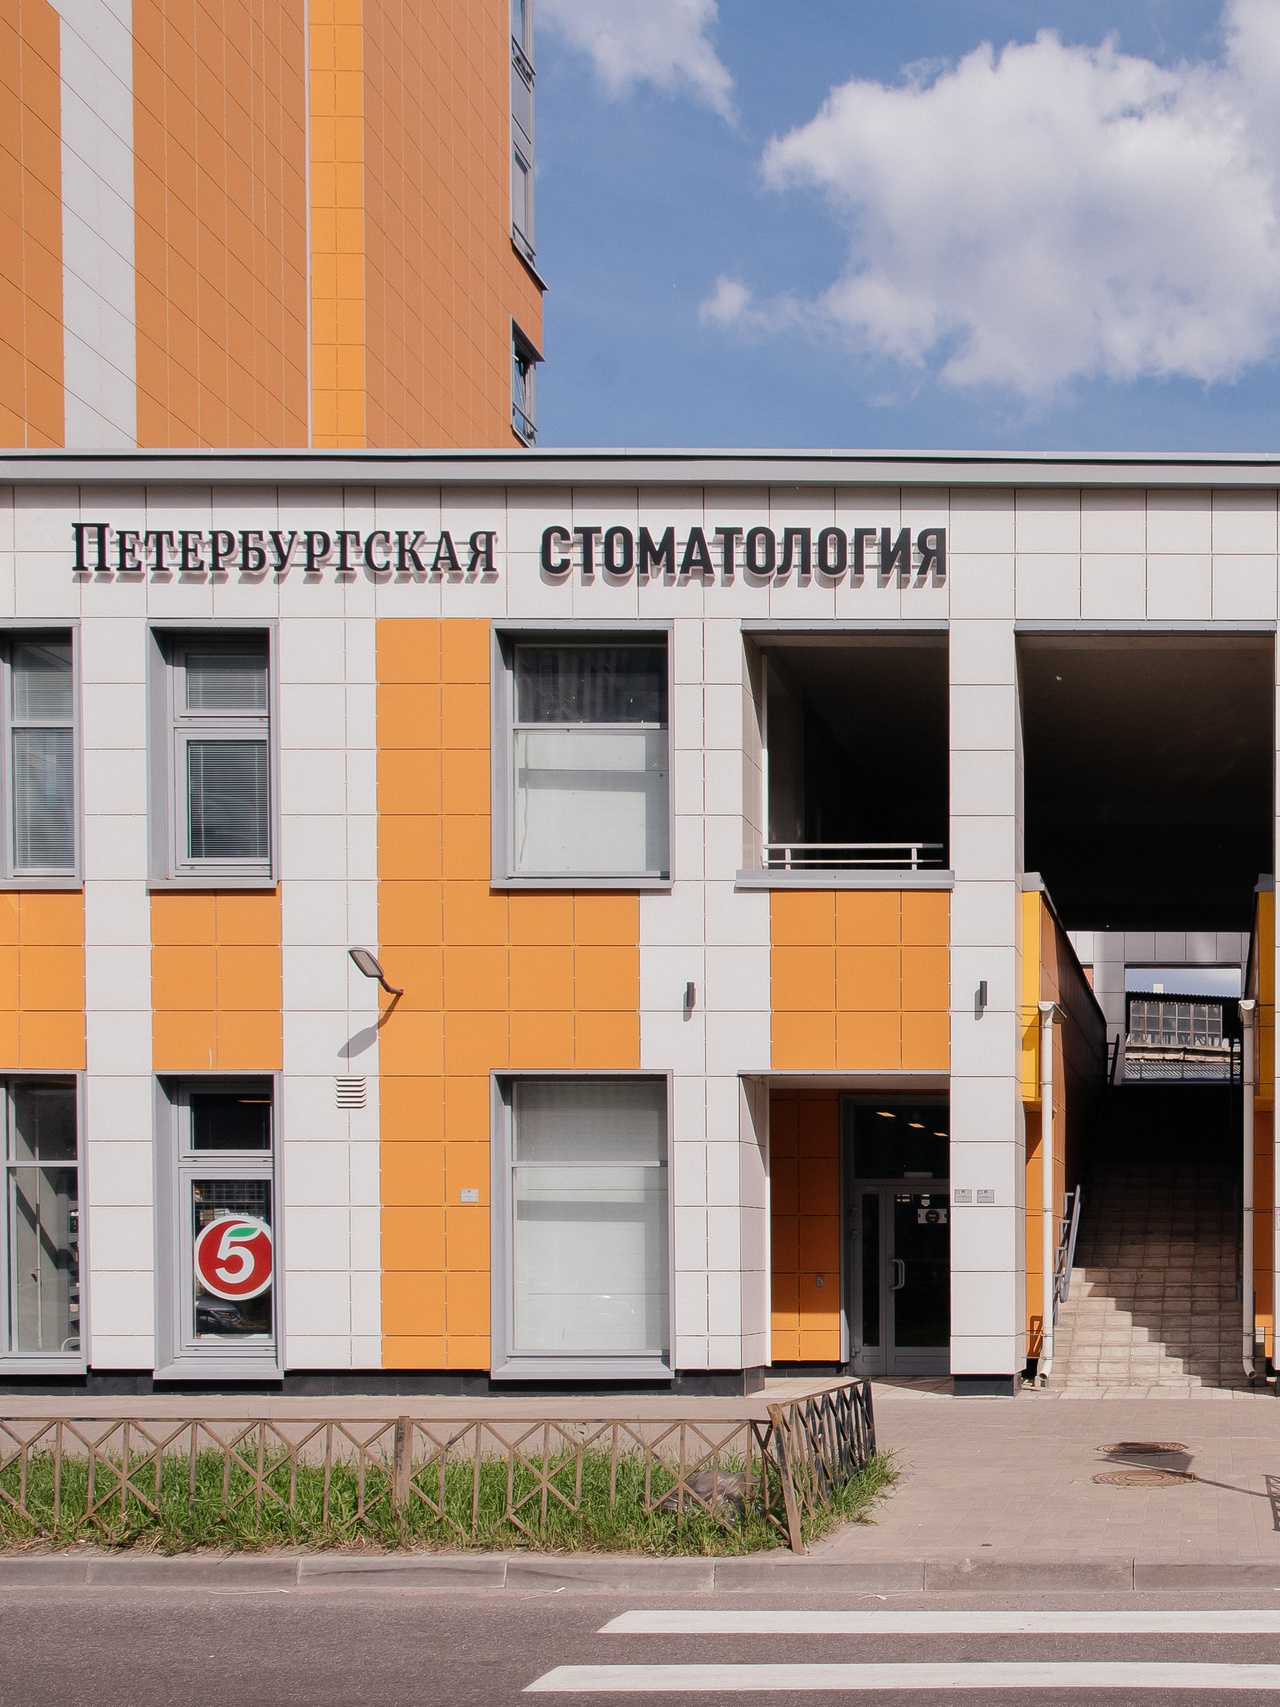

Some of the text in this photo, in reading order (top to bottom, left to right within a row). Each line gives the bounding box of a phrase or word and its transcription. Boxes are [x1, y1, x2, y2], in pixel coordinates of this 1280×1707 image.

[71, 522, 948, 576] ПЕТЕРБУРГСКАЯ СТОМАТОЛОГИЯ
[214, 1223, 262, 1284] 5
